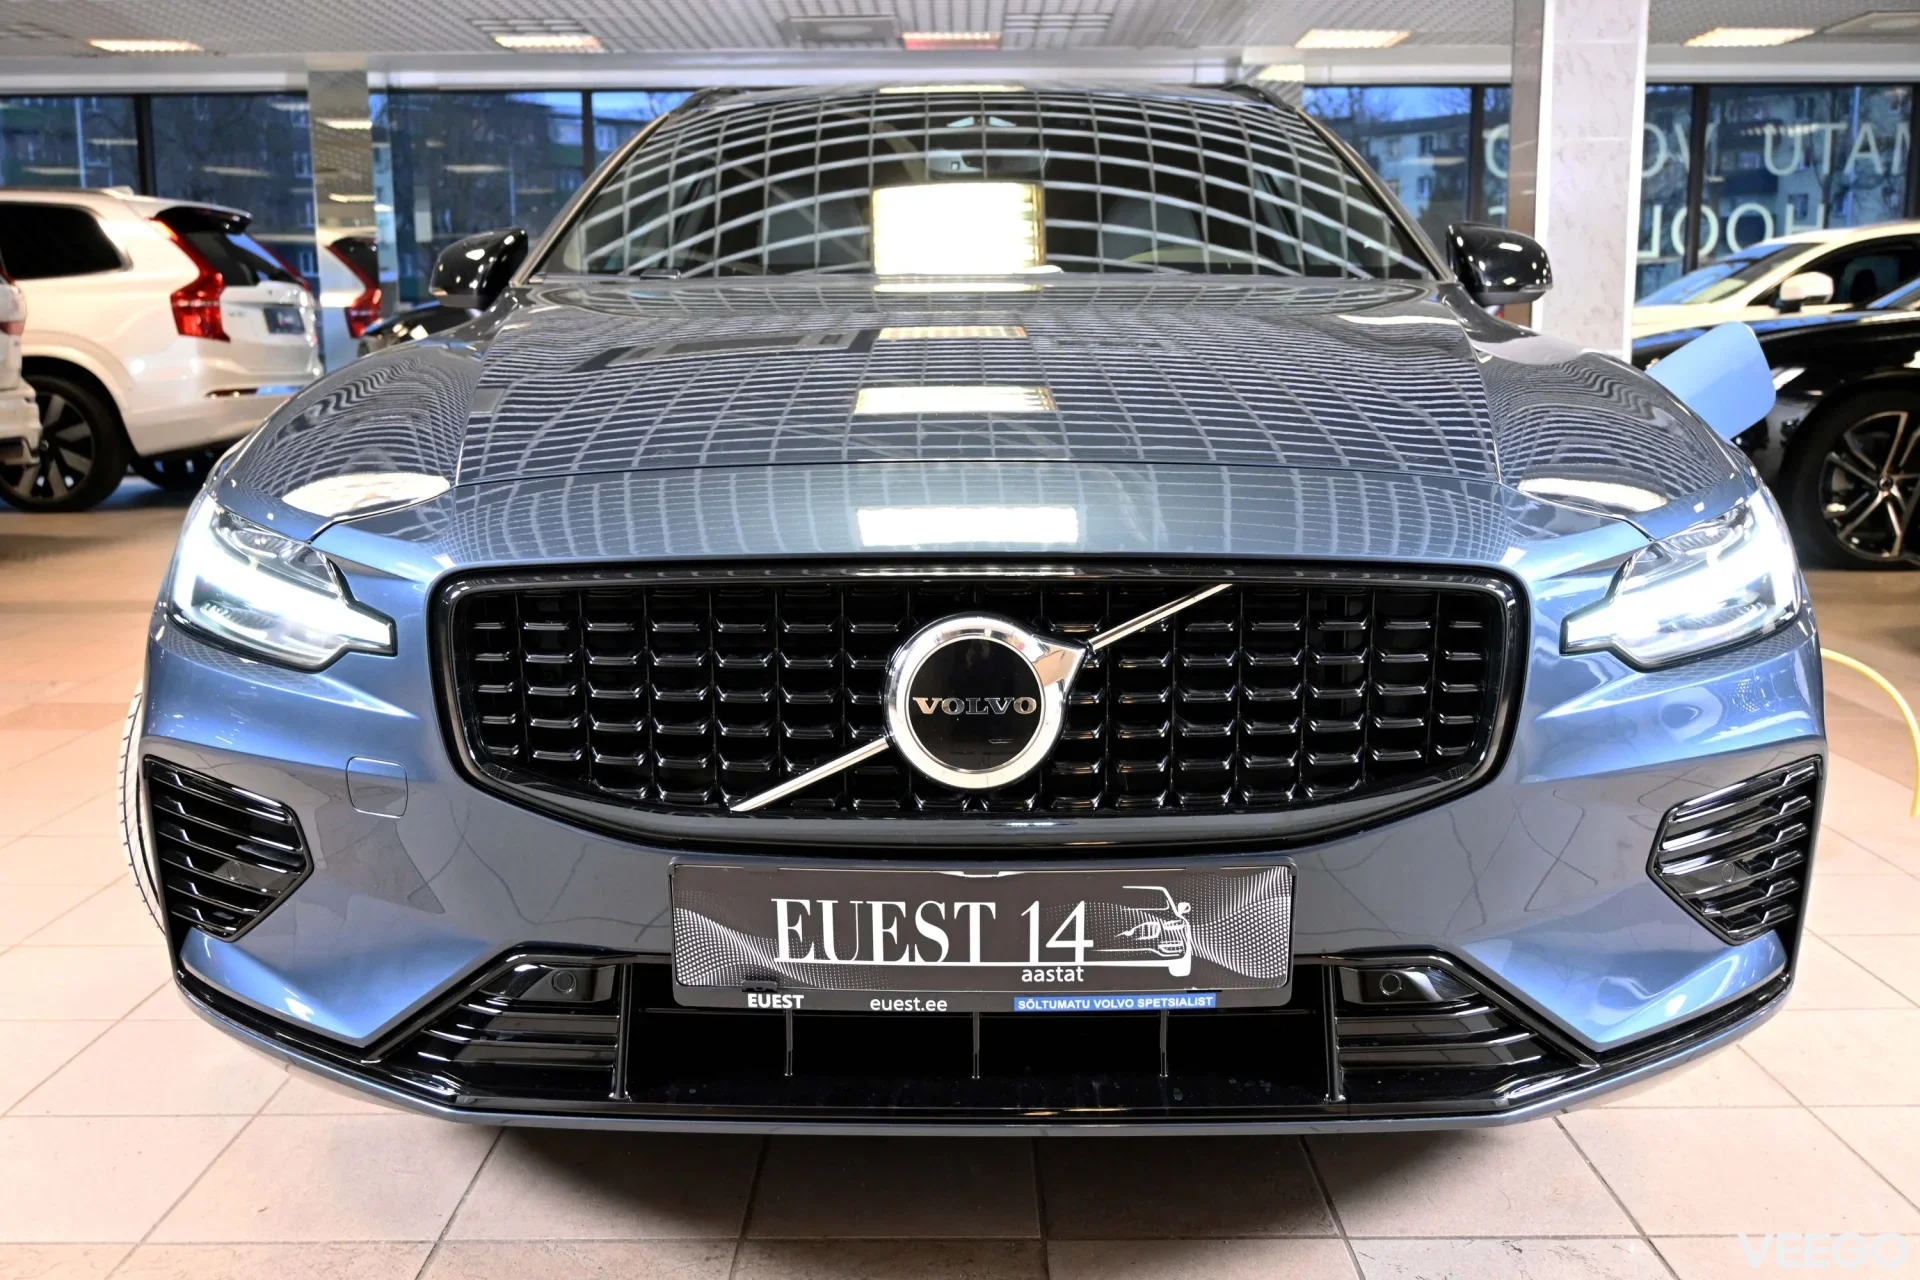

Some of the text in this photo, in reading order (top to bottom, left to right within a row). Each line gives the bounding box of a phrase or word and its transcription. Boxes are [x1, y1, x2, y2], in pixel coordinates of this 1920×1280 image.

[912, 697, 1037, 715] VOLVO
[771, 898, 1094, 964] EUEST 14
[1021, 966, 1085, 982] aastat
[747, 993, 804, 1009] EUEST
[870, 997, 948, 1012] euest.ee
[1018, 996, 1213, 1010] SÕLTUMATU VOLVO SPETSIALIST
